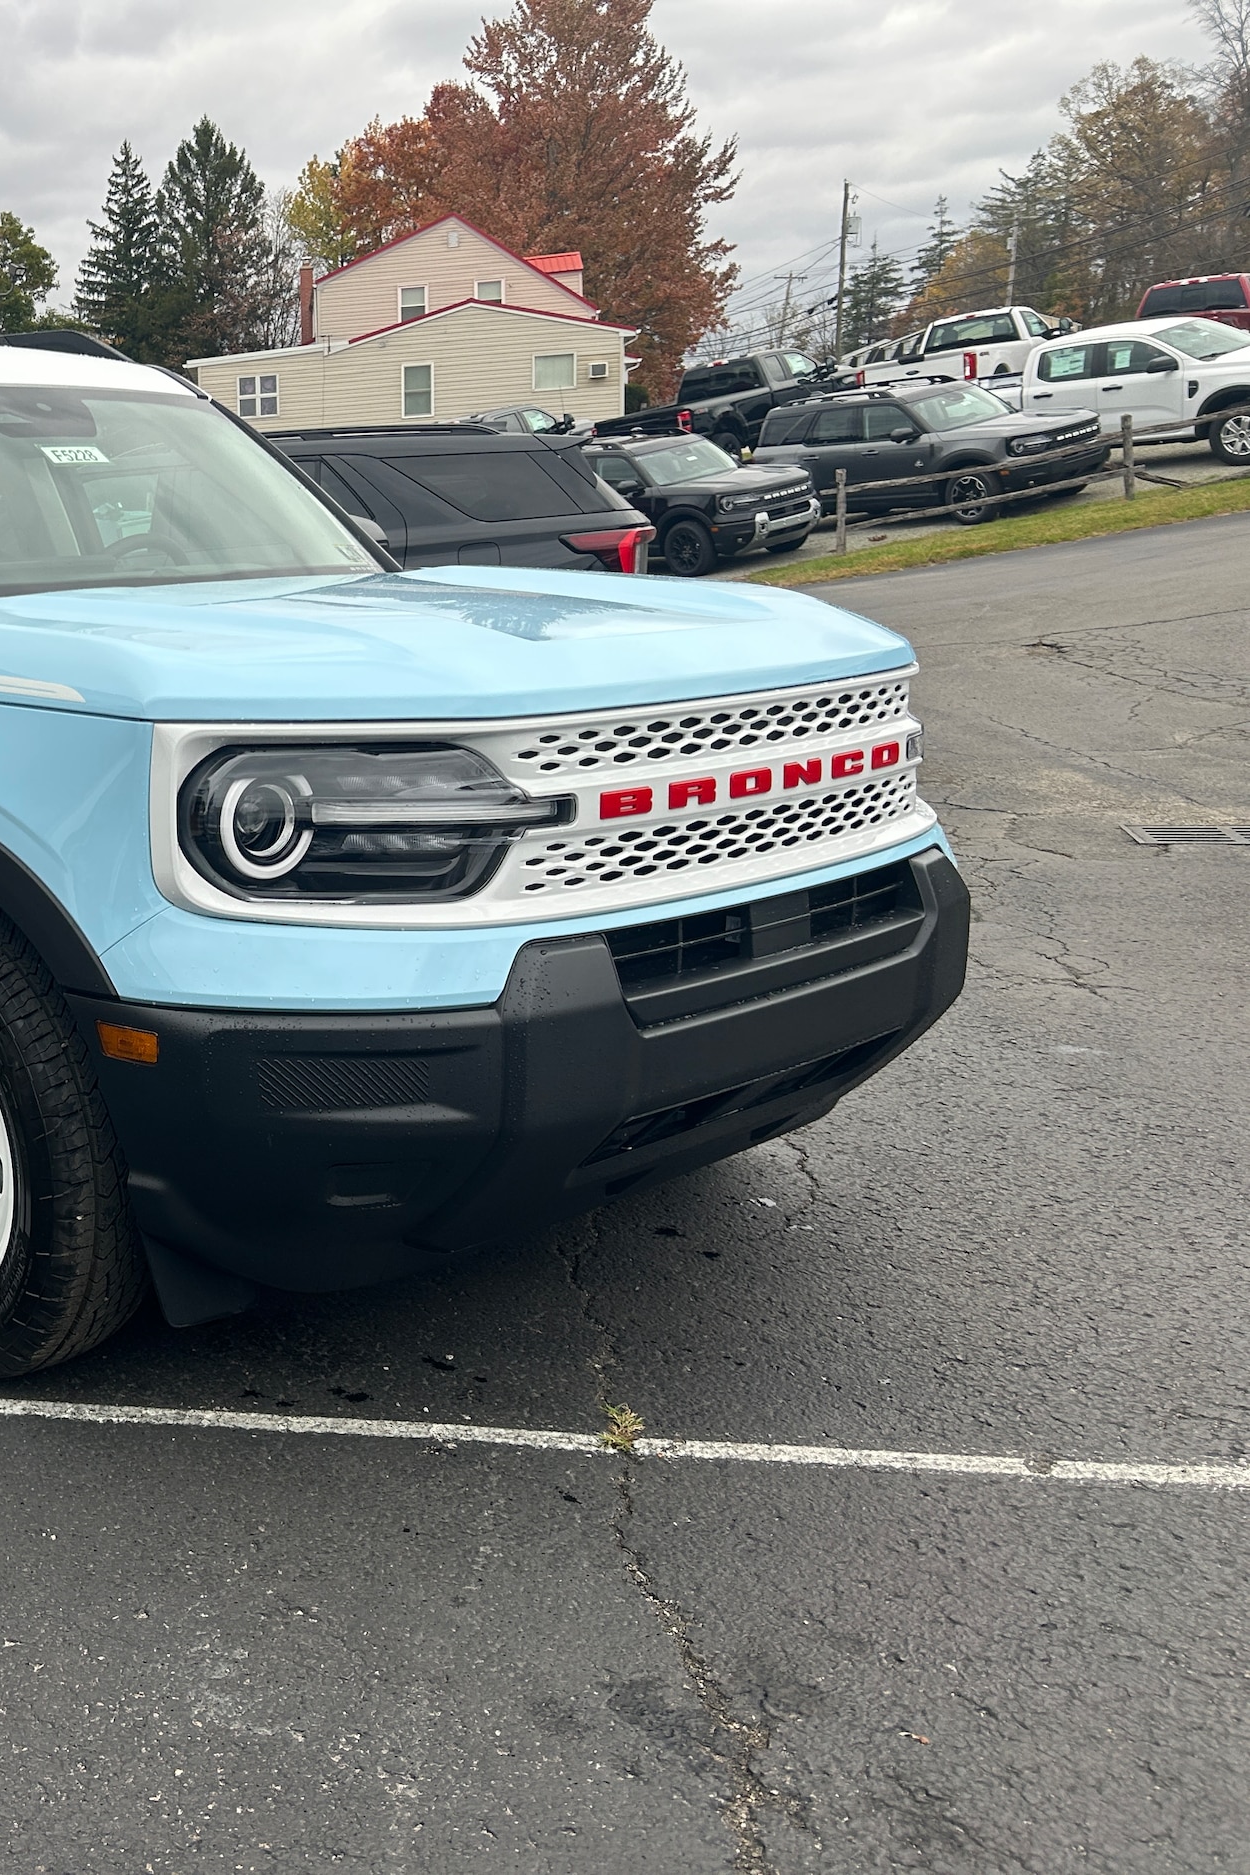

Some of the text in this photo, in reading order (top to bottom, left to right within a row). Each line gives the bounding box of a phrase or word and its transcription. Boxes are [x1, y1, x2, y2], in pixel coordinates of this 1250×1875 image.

[1056, 425, 1098, 441] BRONCO
[51, 449, 99, 462] F5228
[763, 485, 808, 500] BRONCO
[600, 741, 900, 820] BRONCO
